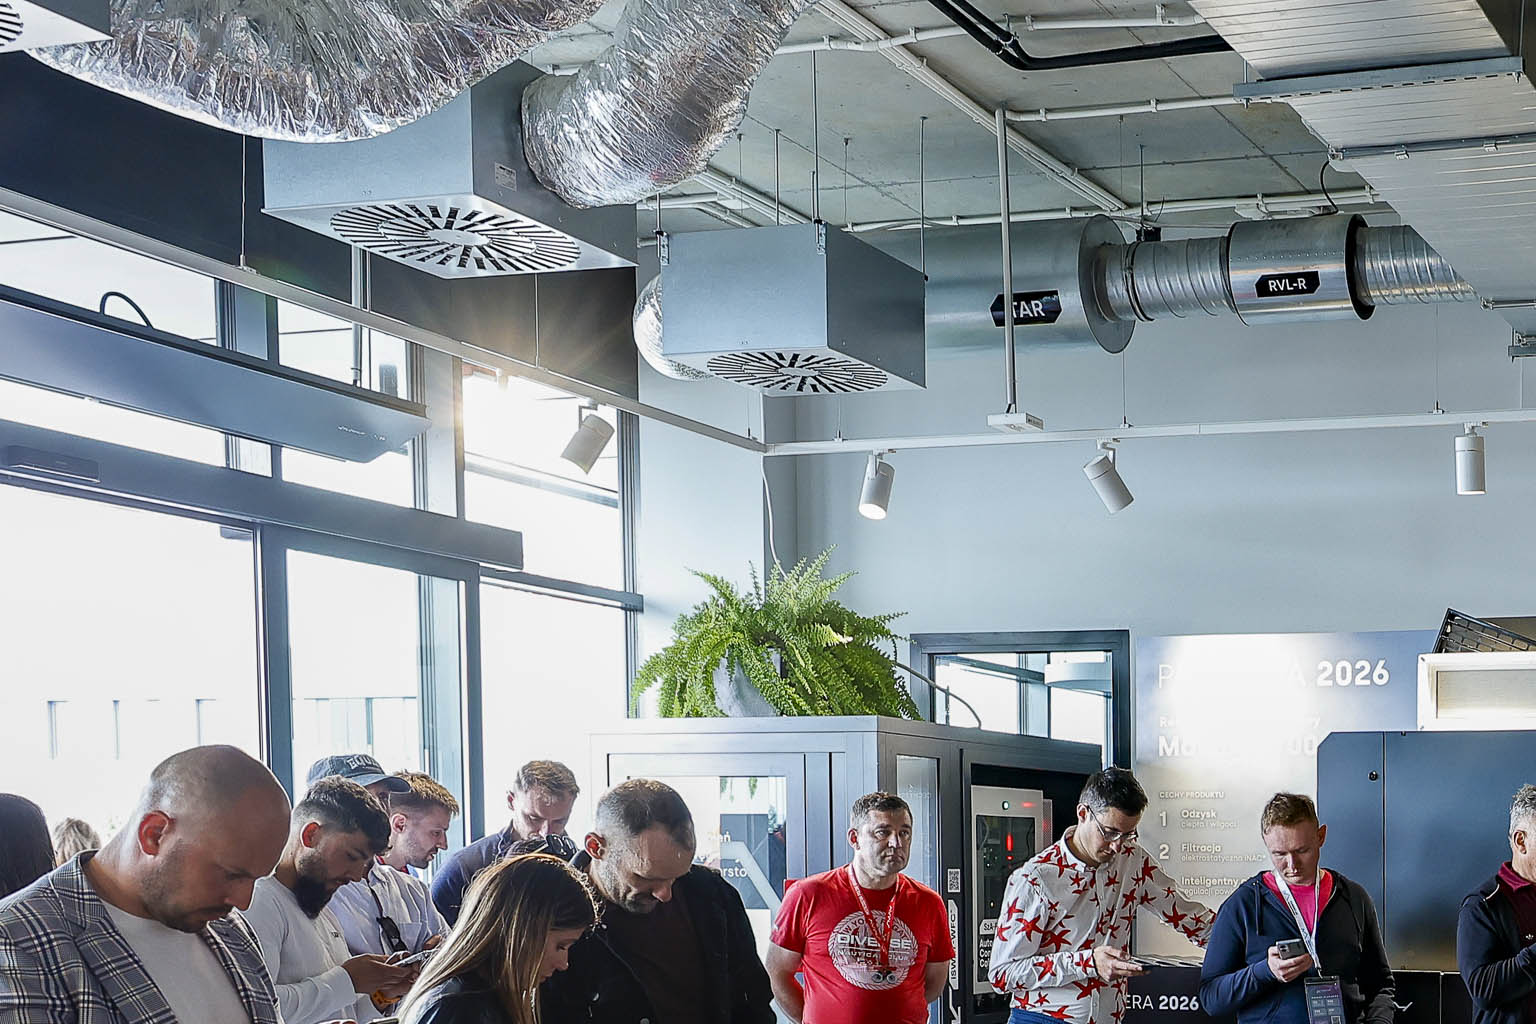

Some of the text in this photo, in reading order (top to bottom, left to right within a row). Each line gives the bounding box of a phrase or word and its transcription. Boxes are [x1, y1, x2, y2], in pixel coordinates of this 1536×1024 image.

[1269, 277, 1307, 293] RVL-R
[1012, 300, 1045, 318] TAR
[1316, 659, 1390, 687] 2026
[1159, 791, 1183, 799] CECHY
[1159, 811, 1168, 827] 1
[1180, 809, 1217, 821] Odzysk
[1159, 844, 1170, 860] 2
[1181, 843, 1222, 854] Filtracja
[1181, 876, 1239, 888] Inteligentny
[837, 934, 912, 950] DIVESE
[979, 938, 993, 948] Auto
[838, 950, 879, 958] NAUTICA
[1125, 995, 1200, 1011] ERA 2026
